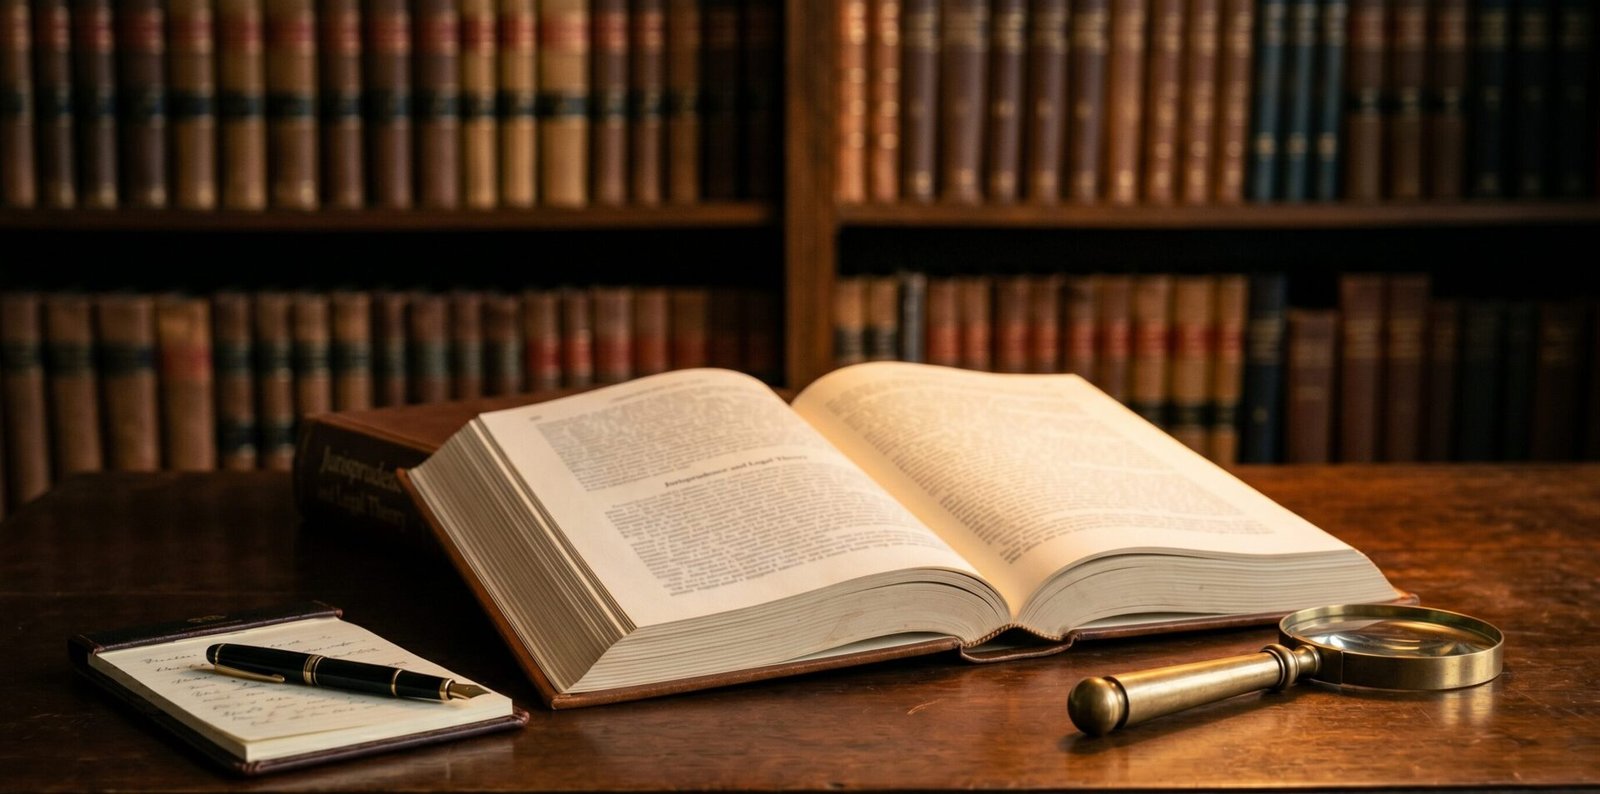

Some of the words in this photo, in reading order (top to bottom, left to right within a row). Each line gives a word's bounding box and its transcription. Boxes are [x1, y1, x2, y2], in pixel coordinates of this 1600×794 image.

[664, 468, 728, 487] Jurisprudence
[730, 461, 747, 472] and
[748, 456, 774, 468] Legal
